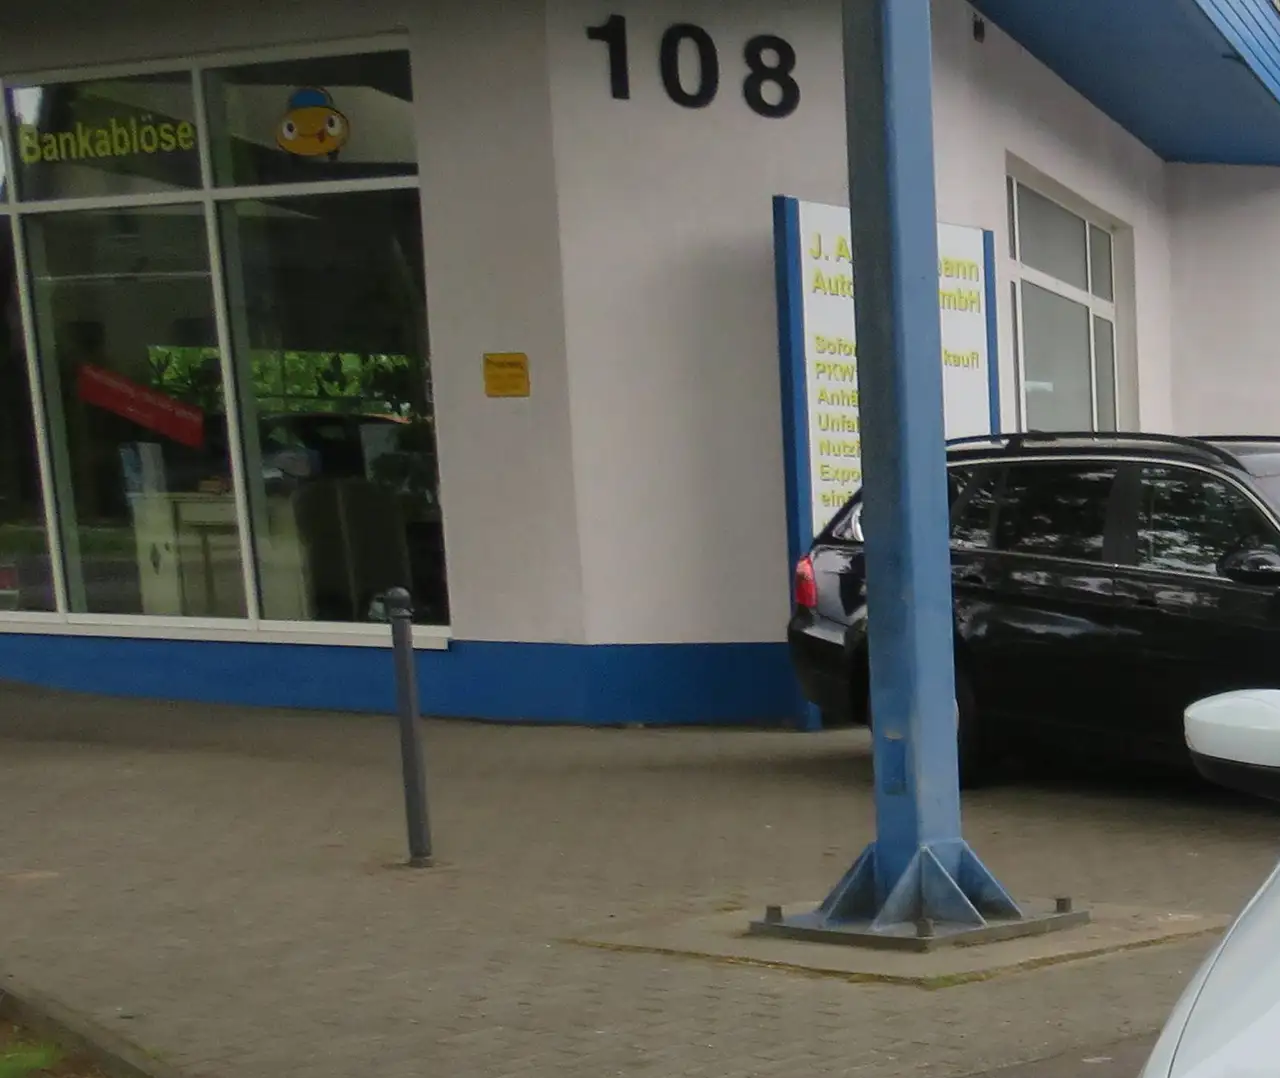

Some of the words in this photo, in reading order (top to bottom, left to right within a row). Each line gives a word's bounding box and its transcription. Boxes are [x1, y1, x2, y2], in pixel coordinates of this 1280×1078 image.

[586, 14, 800, 118] 108
[18, 113, 196, 163] Bankablöse
[938, 259, 980, 284] ann
